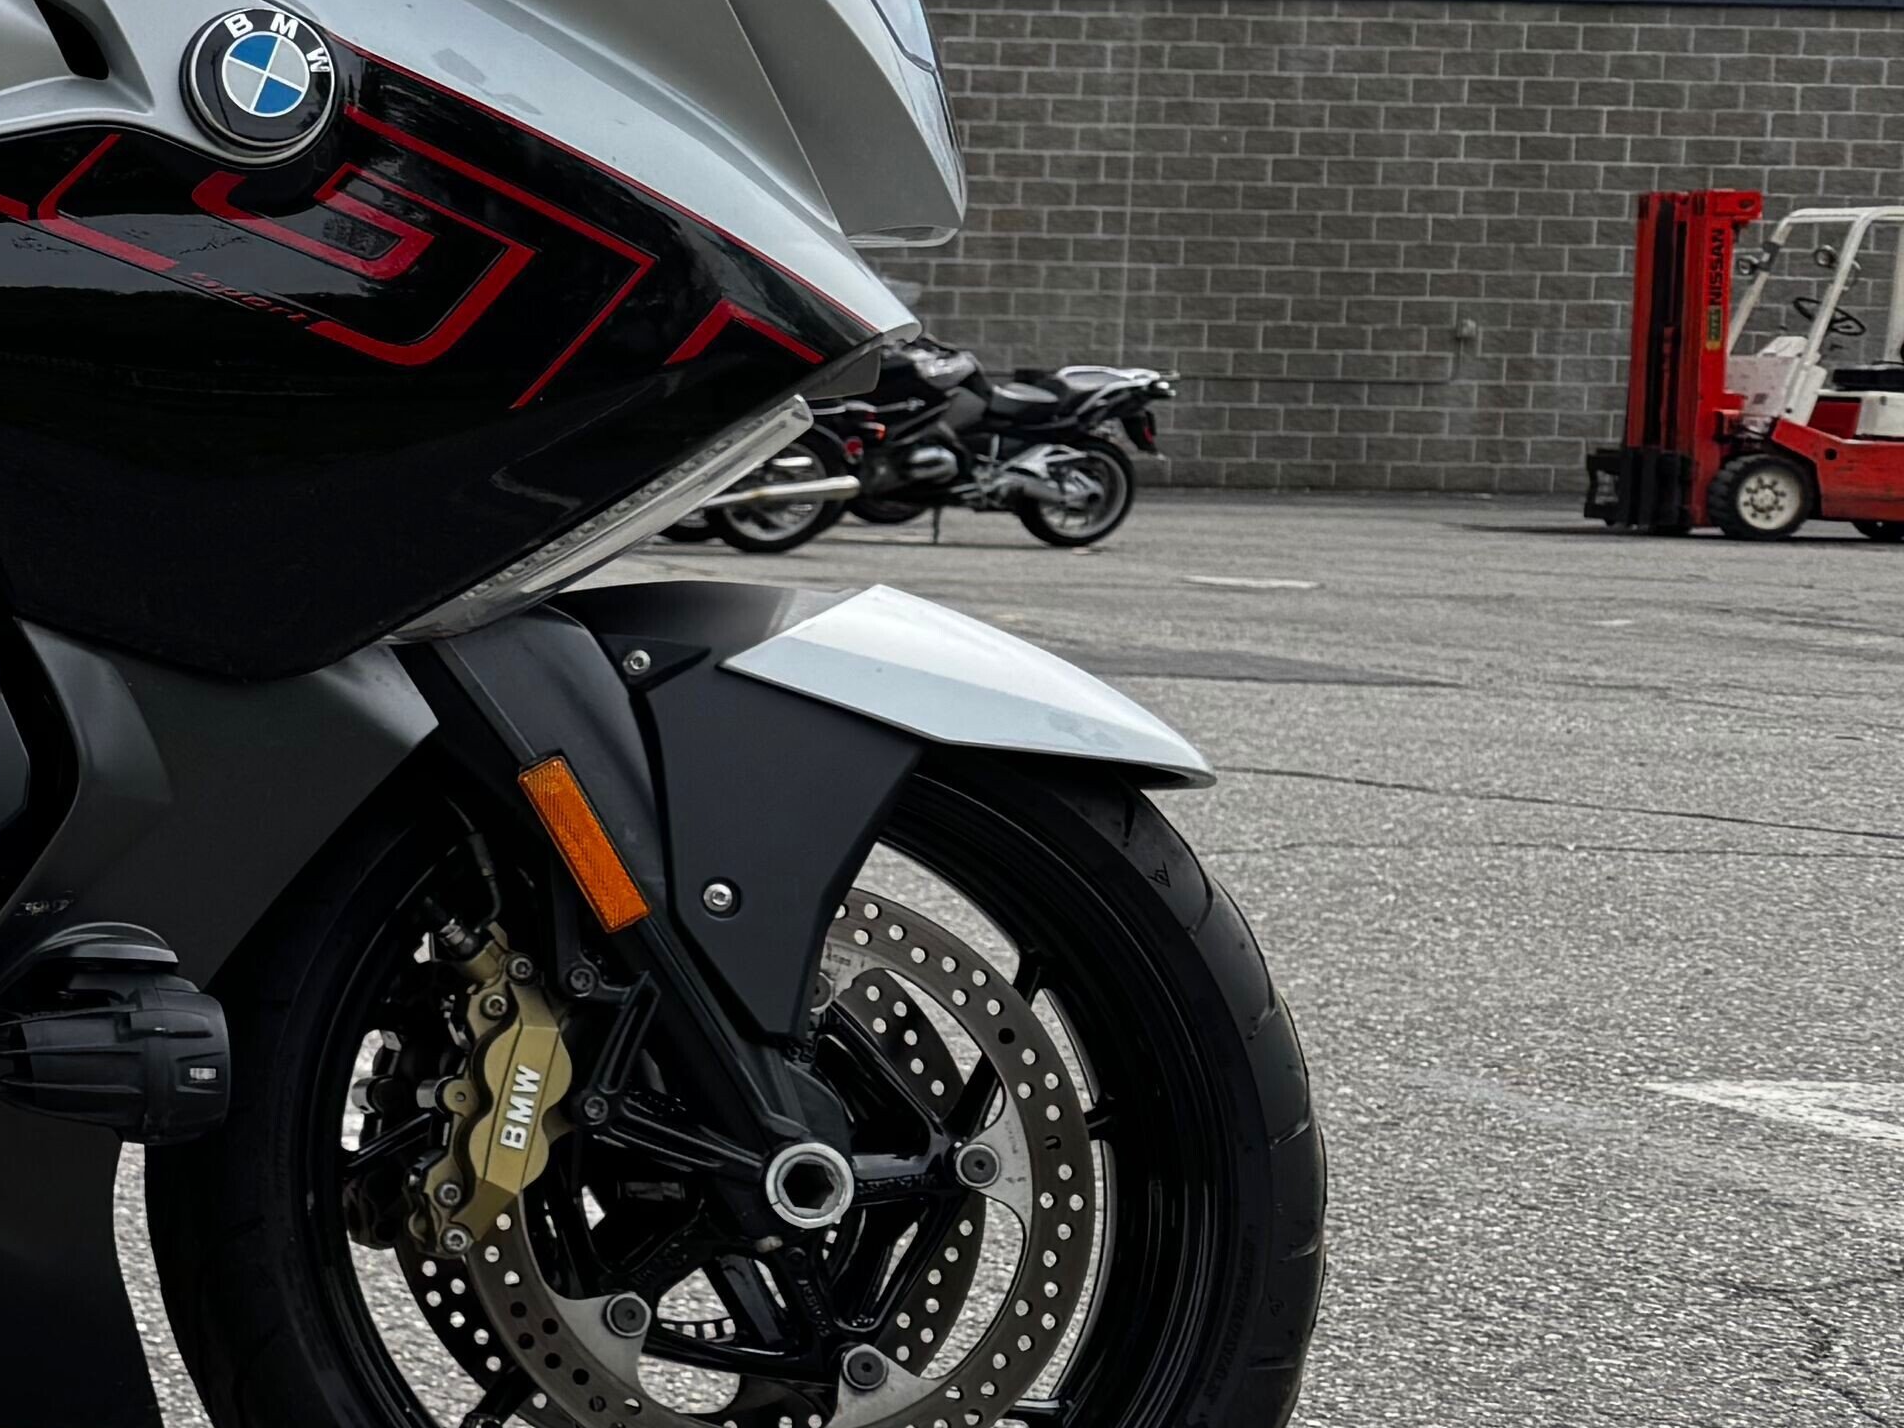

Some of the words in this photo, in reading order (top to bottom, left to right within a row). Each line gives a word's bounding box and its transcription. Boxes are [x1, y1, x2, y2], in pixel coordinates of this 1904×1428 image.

[224, 12, 332, 73] BMW
[1709, 228, 1725, 306] NISSAN
[500, 1064, 541, 1150] BMW
